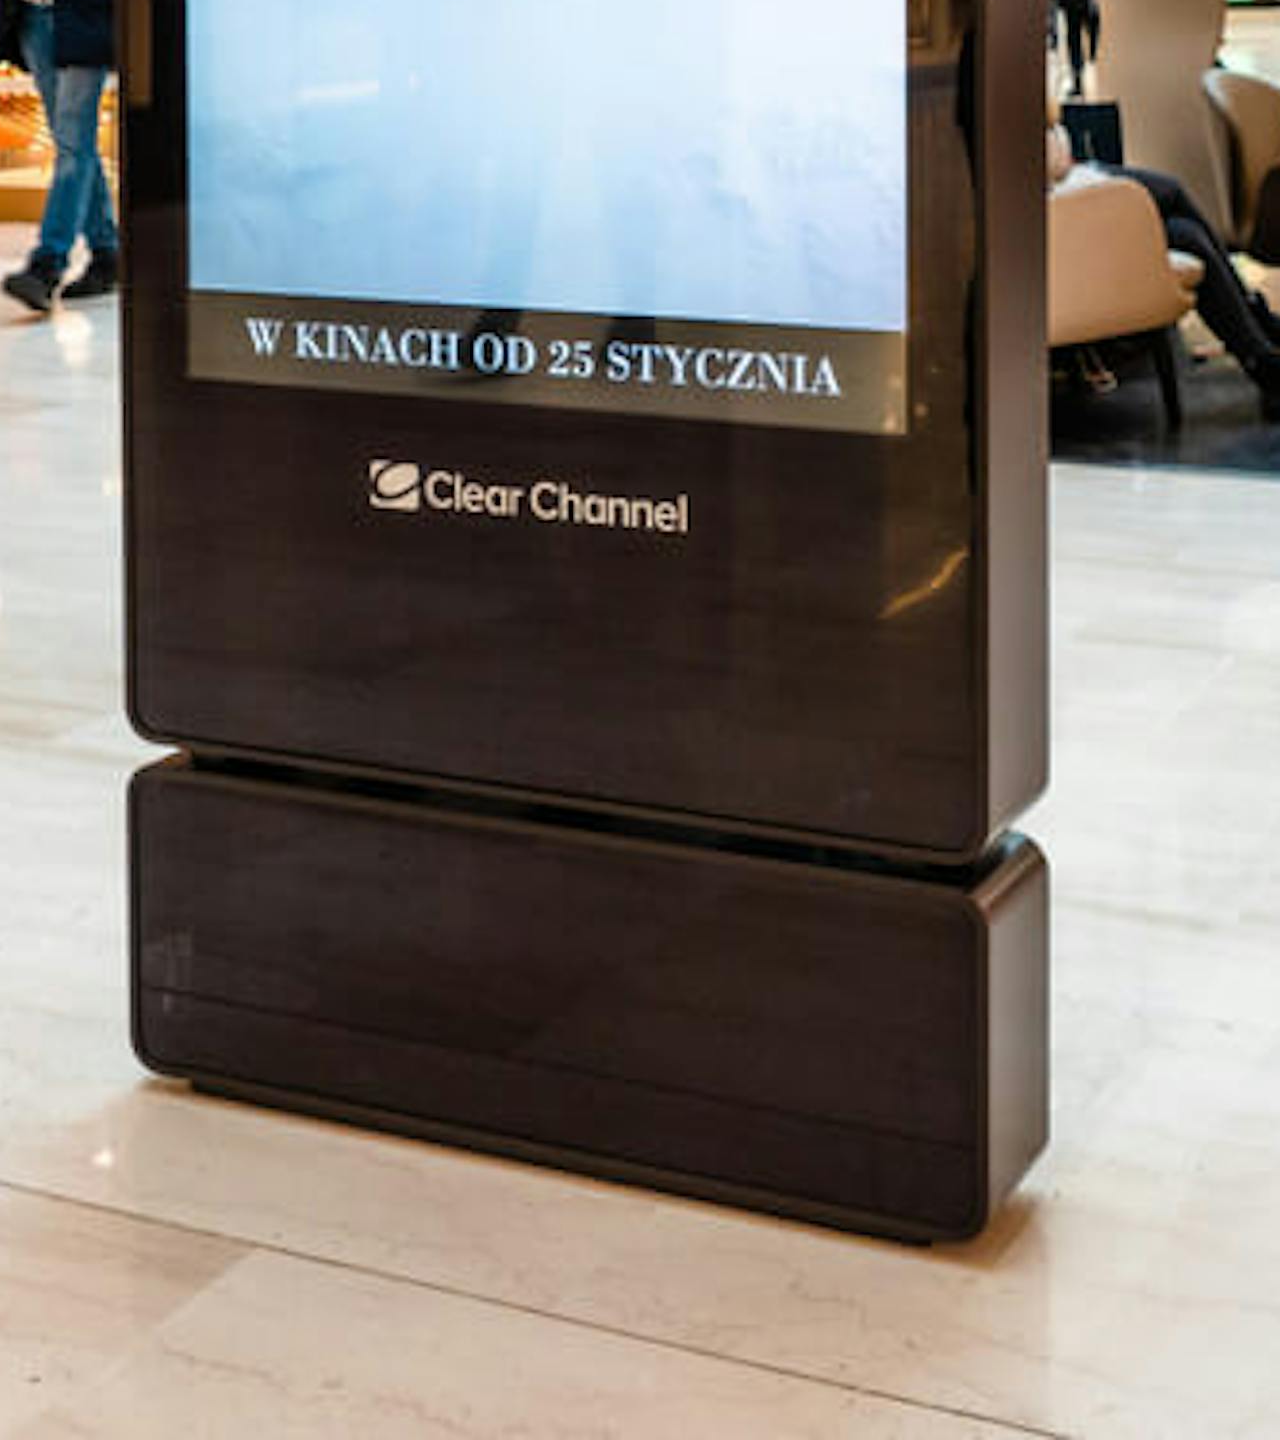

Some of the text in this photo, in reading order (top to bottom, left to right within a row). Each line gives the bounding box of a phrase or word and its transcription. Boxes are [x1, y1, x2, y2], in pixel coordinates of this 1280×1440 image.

[245, 317, 842, 398] W KINACH OD 25 STYCZNIA
[423, 469, 689, 533] Clear Channel
